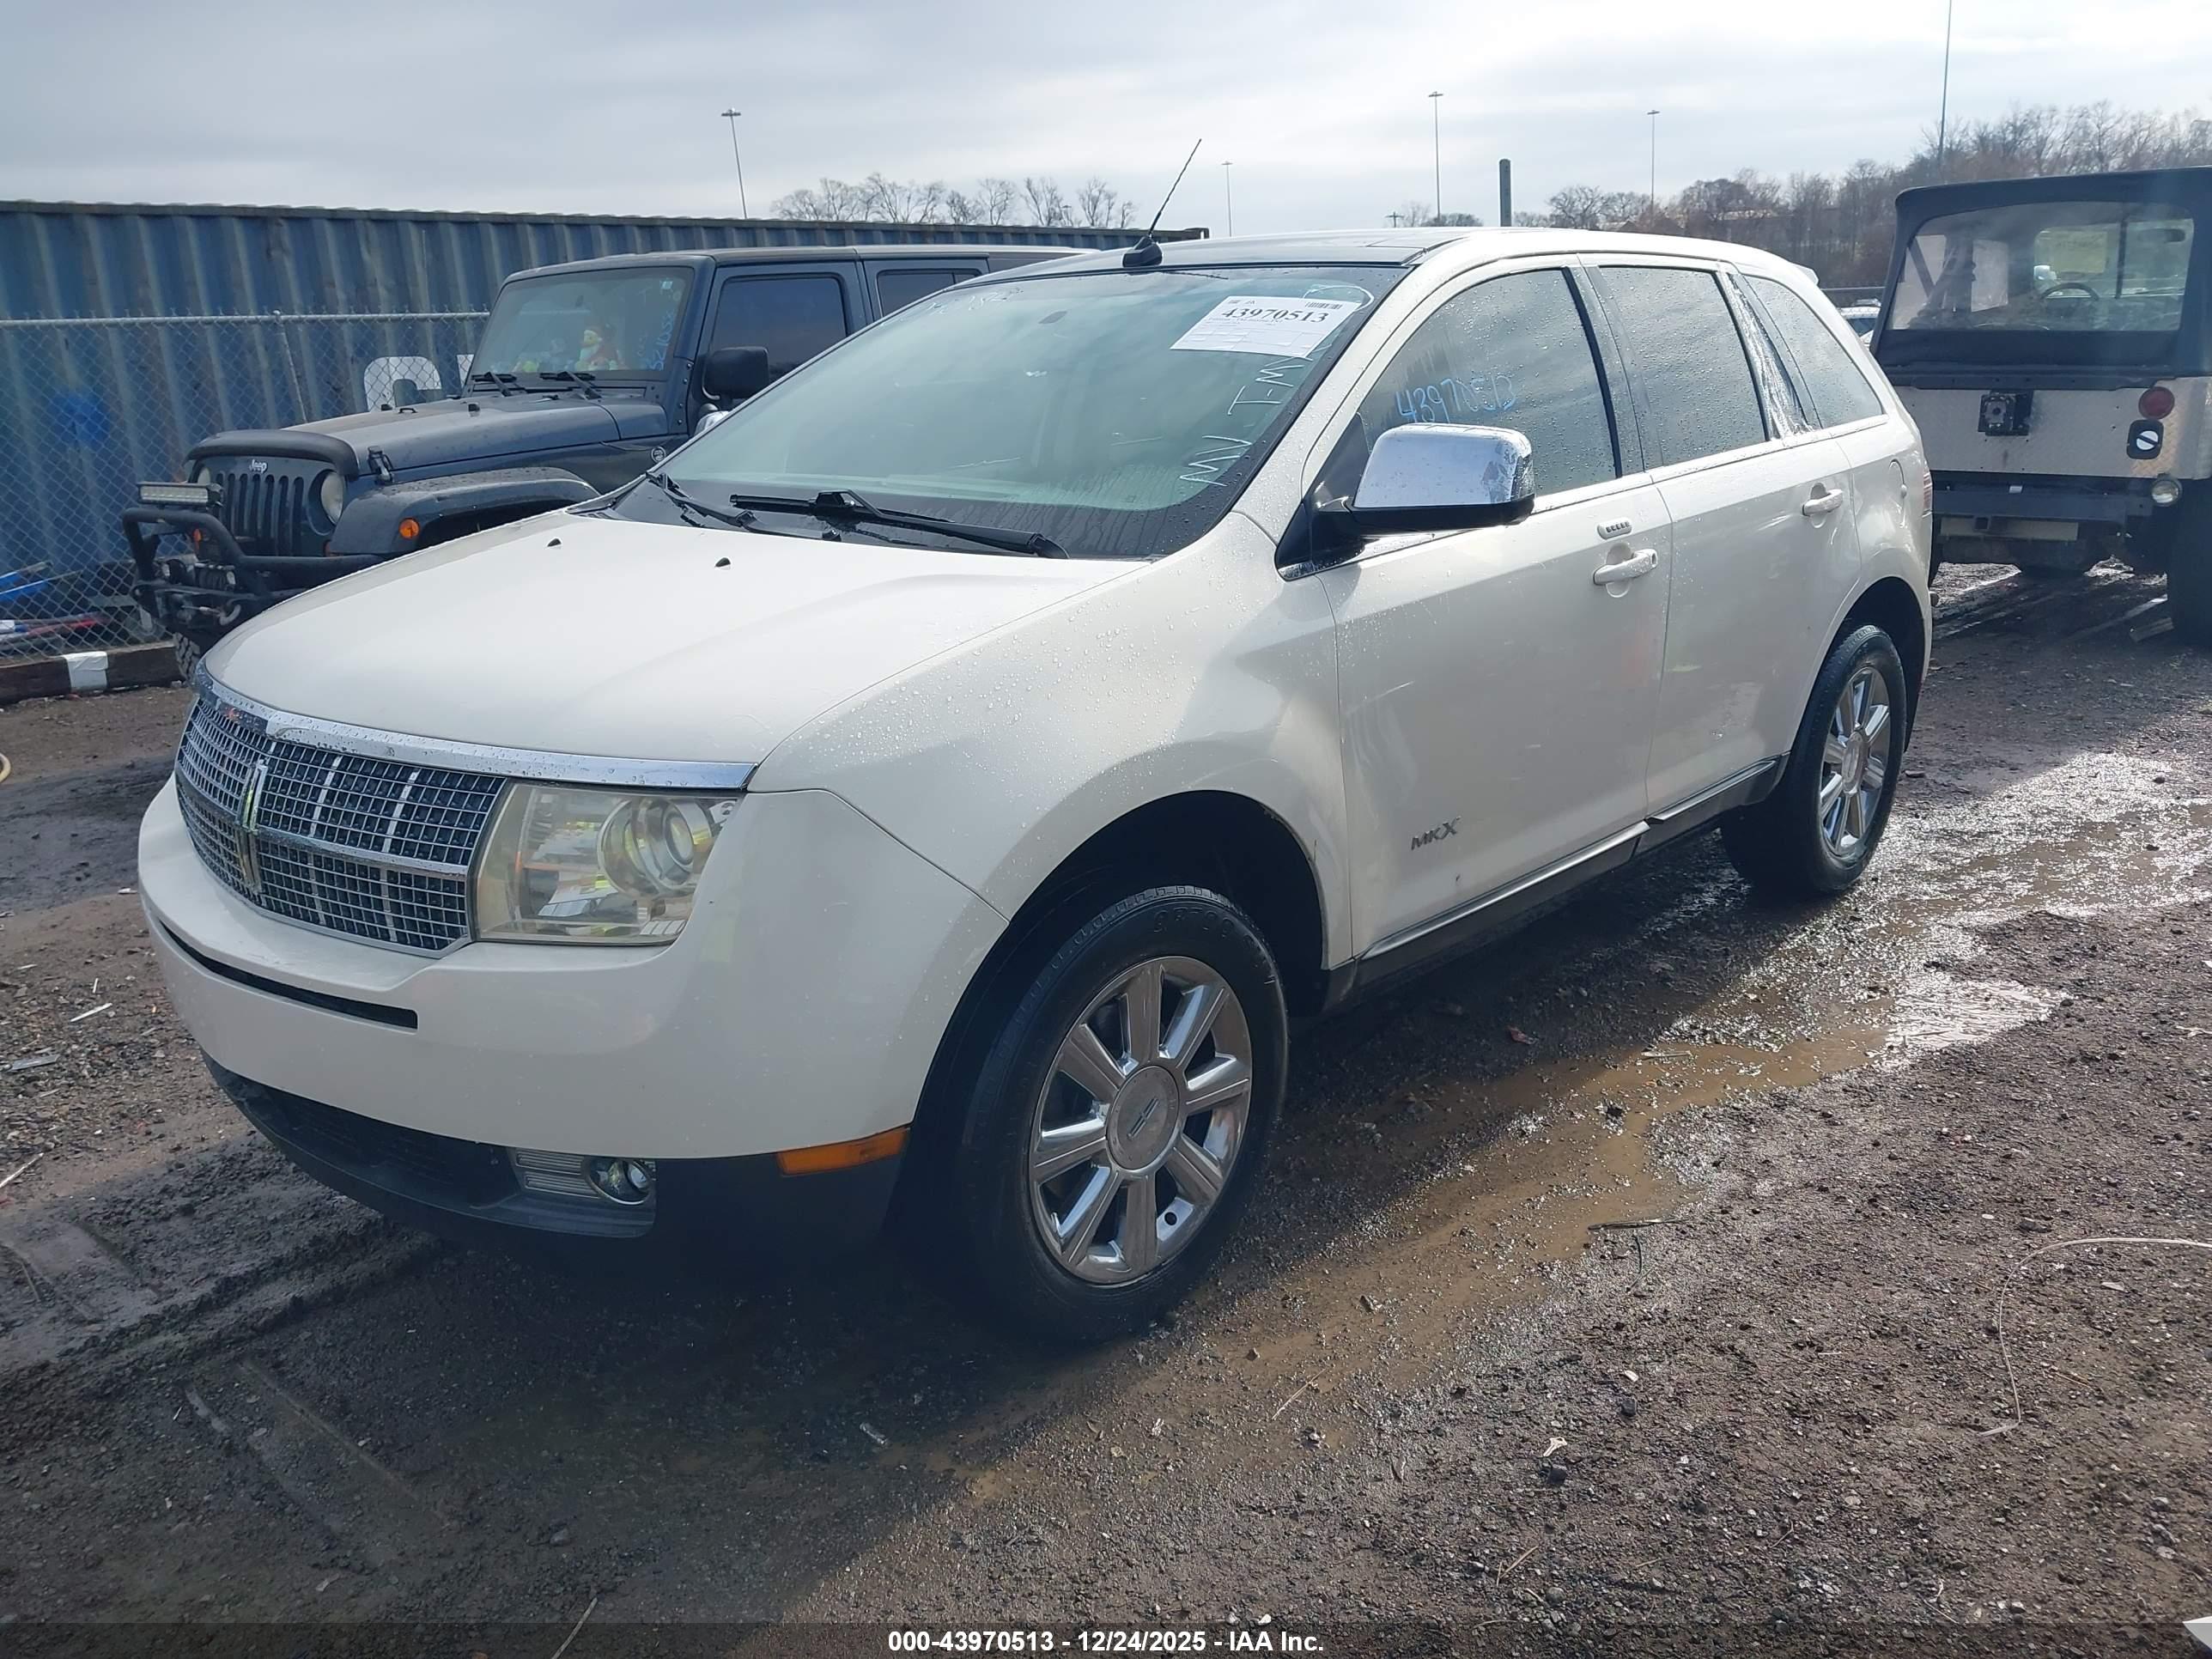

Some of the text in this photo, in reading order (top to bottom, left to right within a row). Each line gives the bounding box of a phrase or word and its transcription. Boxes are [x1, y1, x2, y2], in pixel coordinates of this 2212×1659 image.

[1221, 307, 1330, 323] 43970513
[249, 459, 268, 474] Jeep
[1411, 817, 1462, 851] MKX
